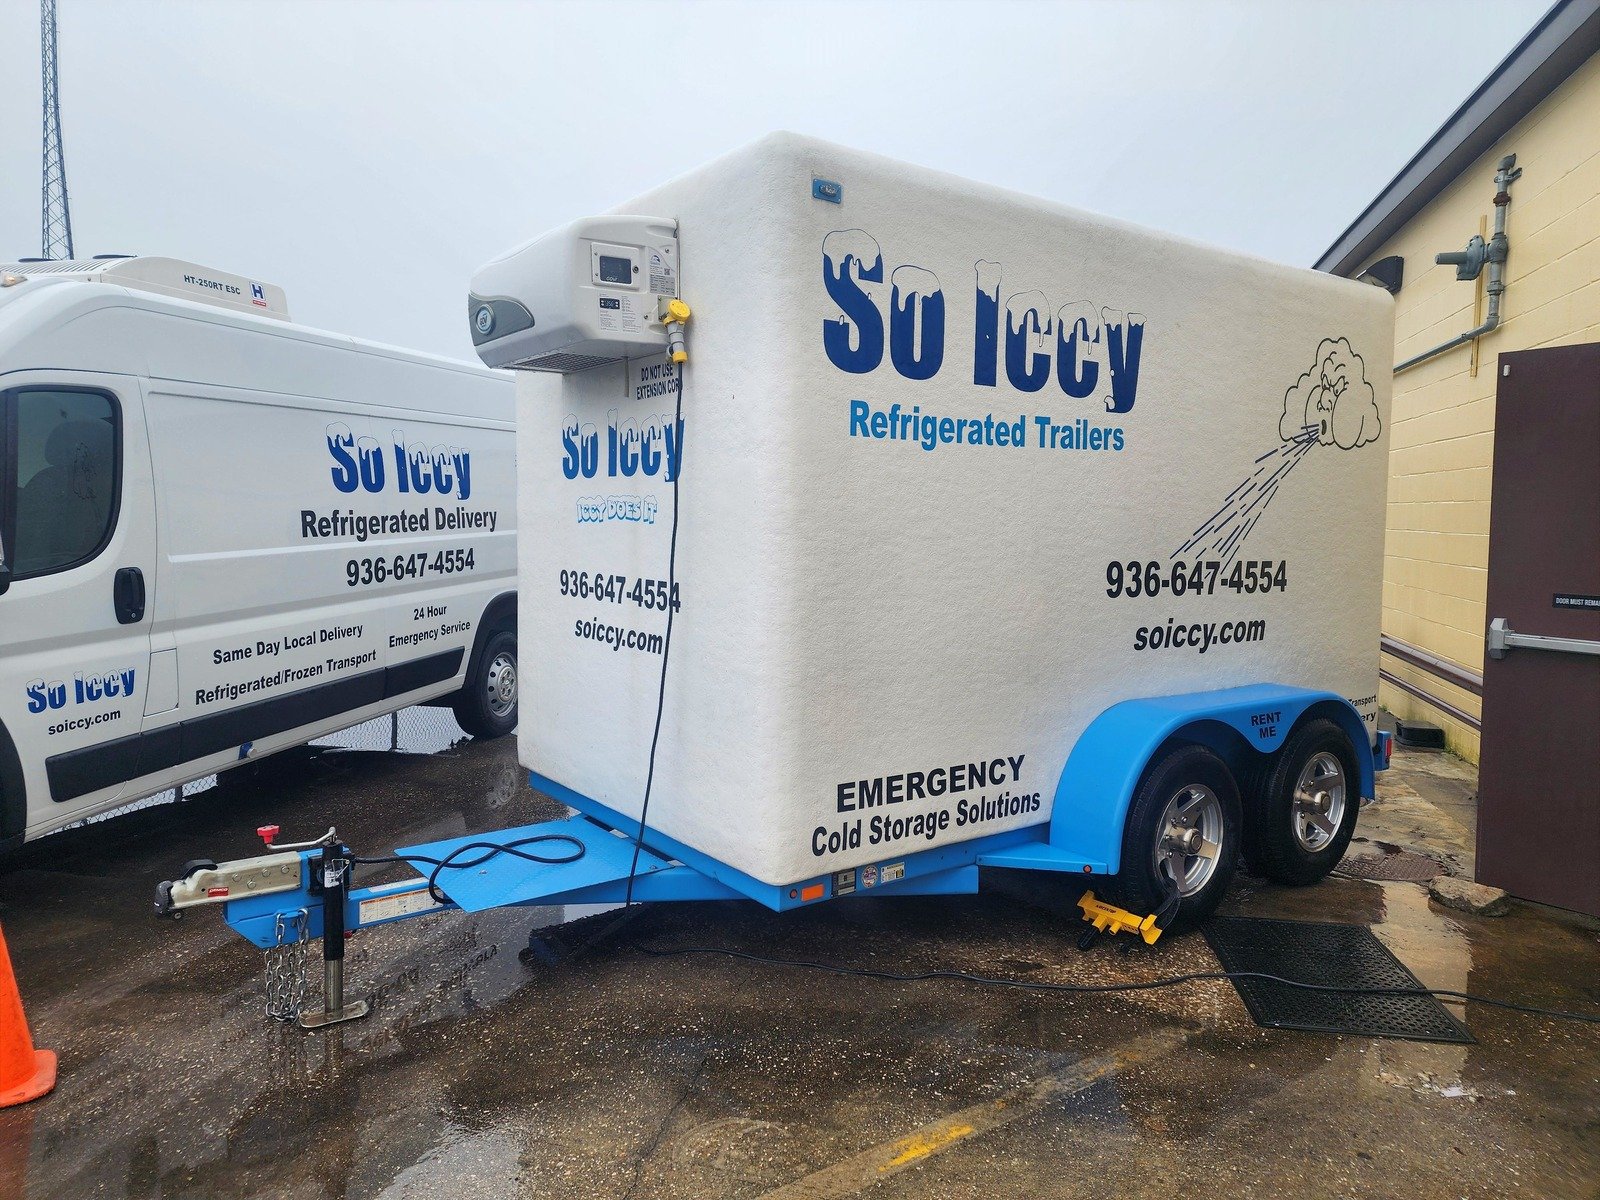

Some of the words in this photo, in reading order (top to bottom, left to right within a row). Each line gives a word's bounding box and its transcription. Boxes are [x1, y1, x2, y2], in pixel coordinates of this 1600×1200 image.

[183, 275, 223, 291] HT-250RT
[226, 285, 241, 295] ESC
[822, 229, 945, 381] So
[974, 259, 1147, 413] Iccy
[636, 381, 667, 400] EXTENSION
[667, 377, 681, 394] COR
[641, 366, 649, 381] DO
[650, 364, 661, 380] NOT
[662, 363, 673, 378] USE
[850, 399, 1026, 451] Refrigerated
[1034, 415, 1125, 451] Trailers
[325, 421, 386, 494] So
[391, 428, 471, 501] Iccy
[562, 414, 598, 480] So
[607, 408, 686, 483] Iccy
[300, 508, 430, 542] Refrigerated
[434, 506, 498, 534] Delivery
[576, 495, 606, 523] ICCY
[607, 495, 641, 521] DOES
[643, 495, 657, 524] IT
[346, 548, 475, 588] 936-647-4554
[1106, 560, 1287, 598] 936-647-4554
[560, 569, 680, 613] 936-647-4554
[1555, 597, 1570, 605] DOOR
[1570, 598, 1584, 606] MUST
[413, 607, 425, 622] 24
[427, 604, 447, 620] Hour
[213, 644, 253, 665] Same
[256, 639, 281, 658] Day
[283, 630, 317, 651] Local
[319, 623, 364, 644] Delivery
[388, 626, 438, 649] Emergency
[441, 619, 471, 637] Service
[575, 617, 663, 654] soiccy.com
[1133, 618, 1266, 654] soiccy.com
[26, 677, 68, 714] So
[74, 663, 136, 705] Iccy
[195, 664, 323, 705] Refrigerated/Frozen
[326, 649, 377, 676] Transport
[48, 707, 121, 736] soiccy.com
[1250, 711, 1282, 727] RENT
[1259, 726, 1276, 739] ME
[837, 754, 1025, 813] EMERGENCY
[812, 819, 862, 857] Cold
[869, 809, 950, 845] Storage
[955, 791, 1041, 827] Solutions
